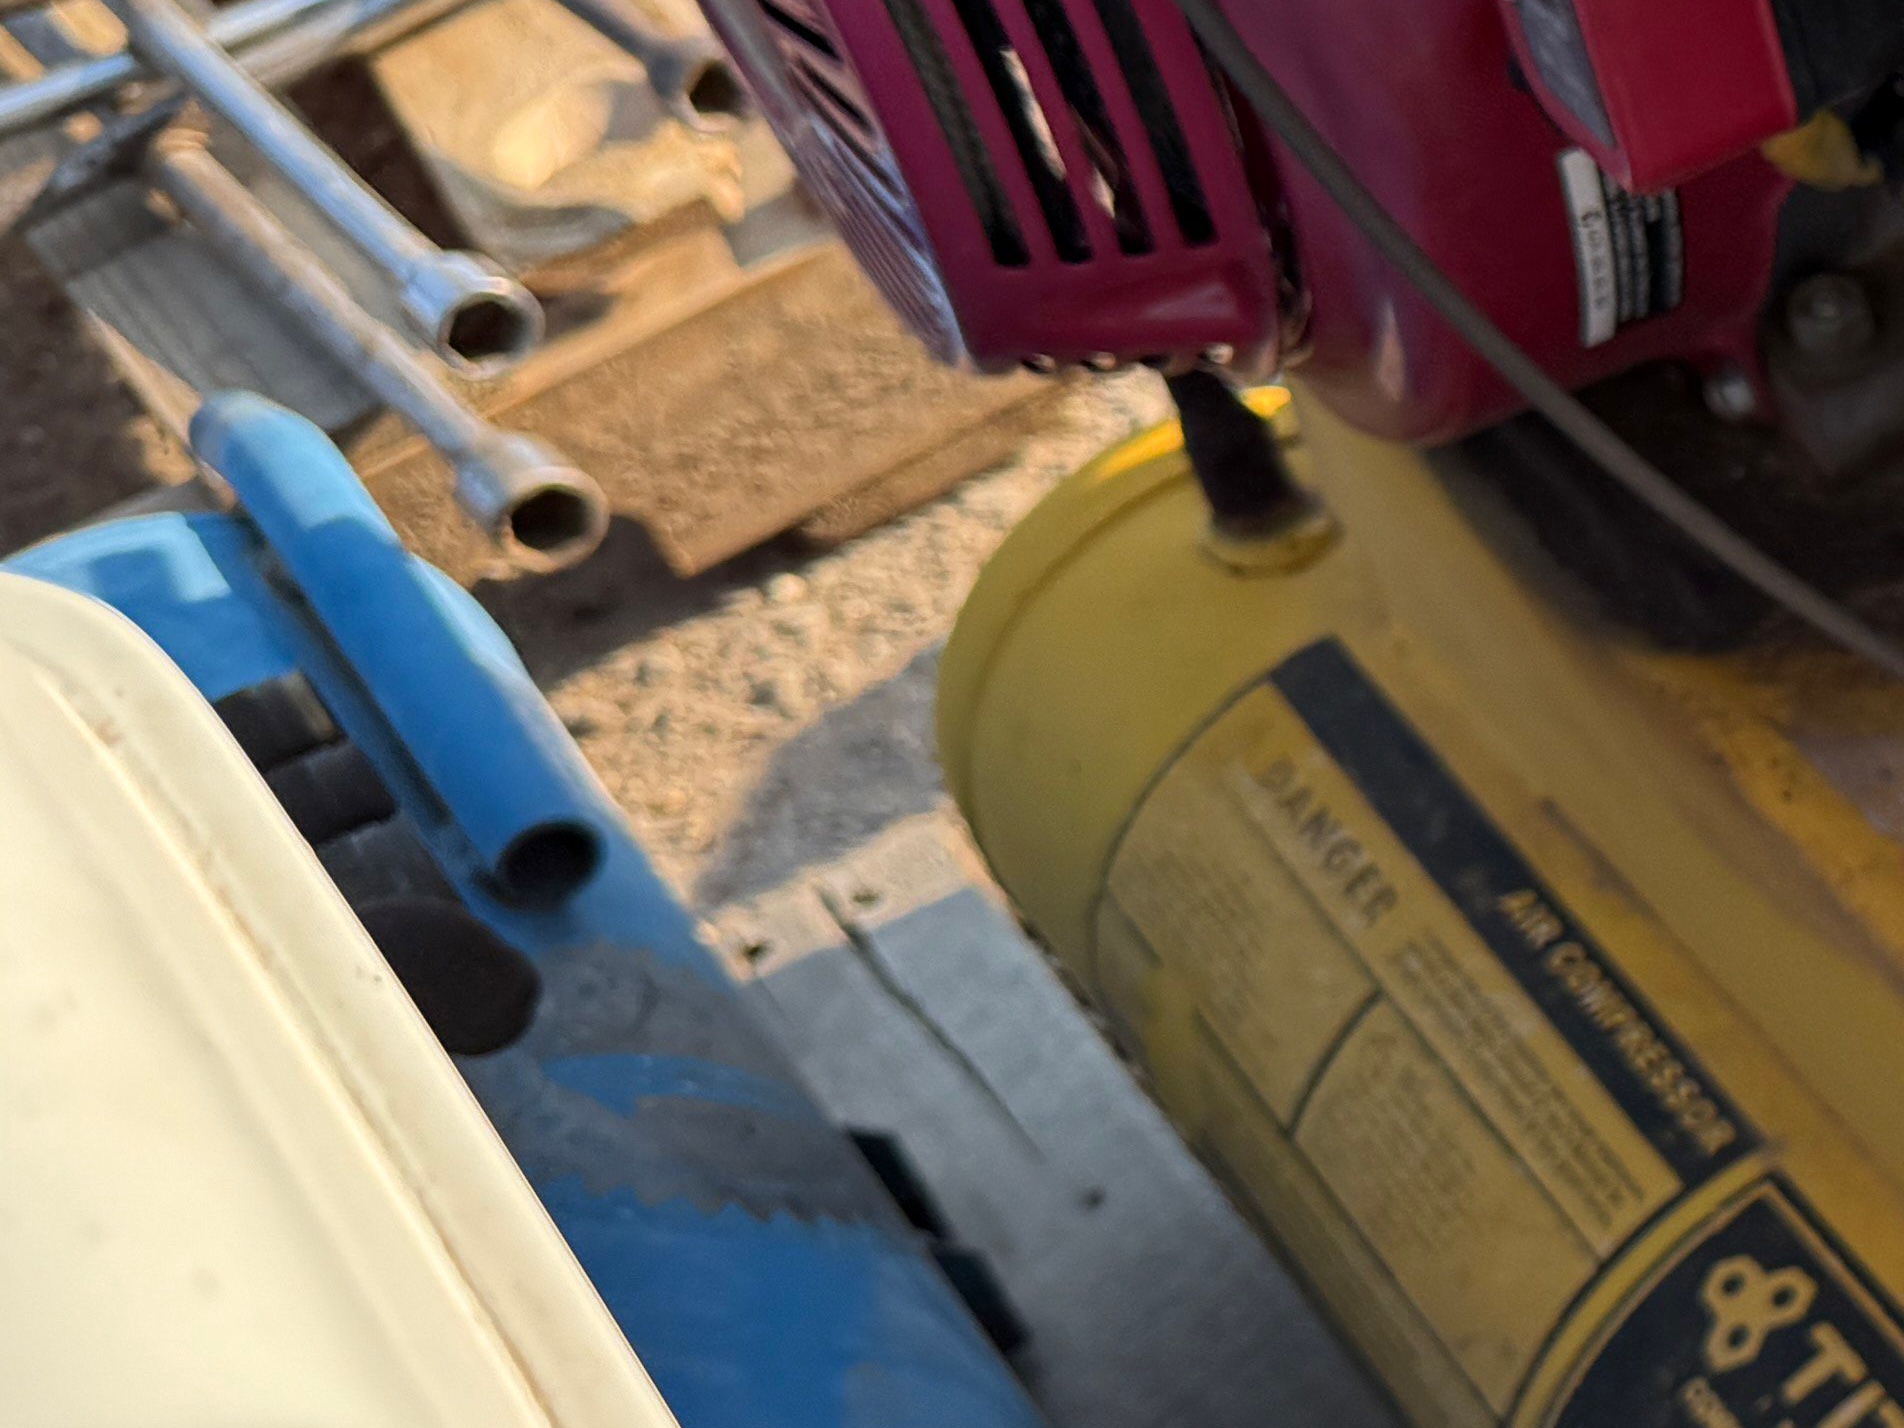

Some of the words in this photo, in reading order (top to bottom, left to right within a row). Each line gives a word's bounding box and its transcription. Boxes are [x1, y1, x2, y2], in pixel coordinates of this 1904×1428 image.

[1256, 758, 1398, 929] DANGER
[1499, 888, 1564, 951] AIR
[1546, 941, 1737, 1158] COMPRESSOR
